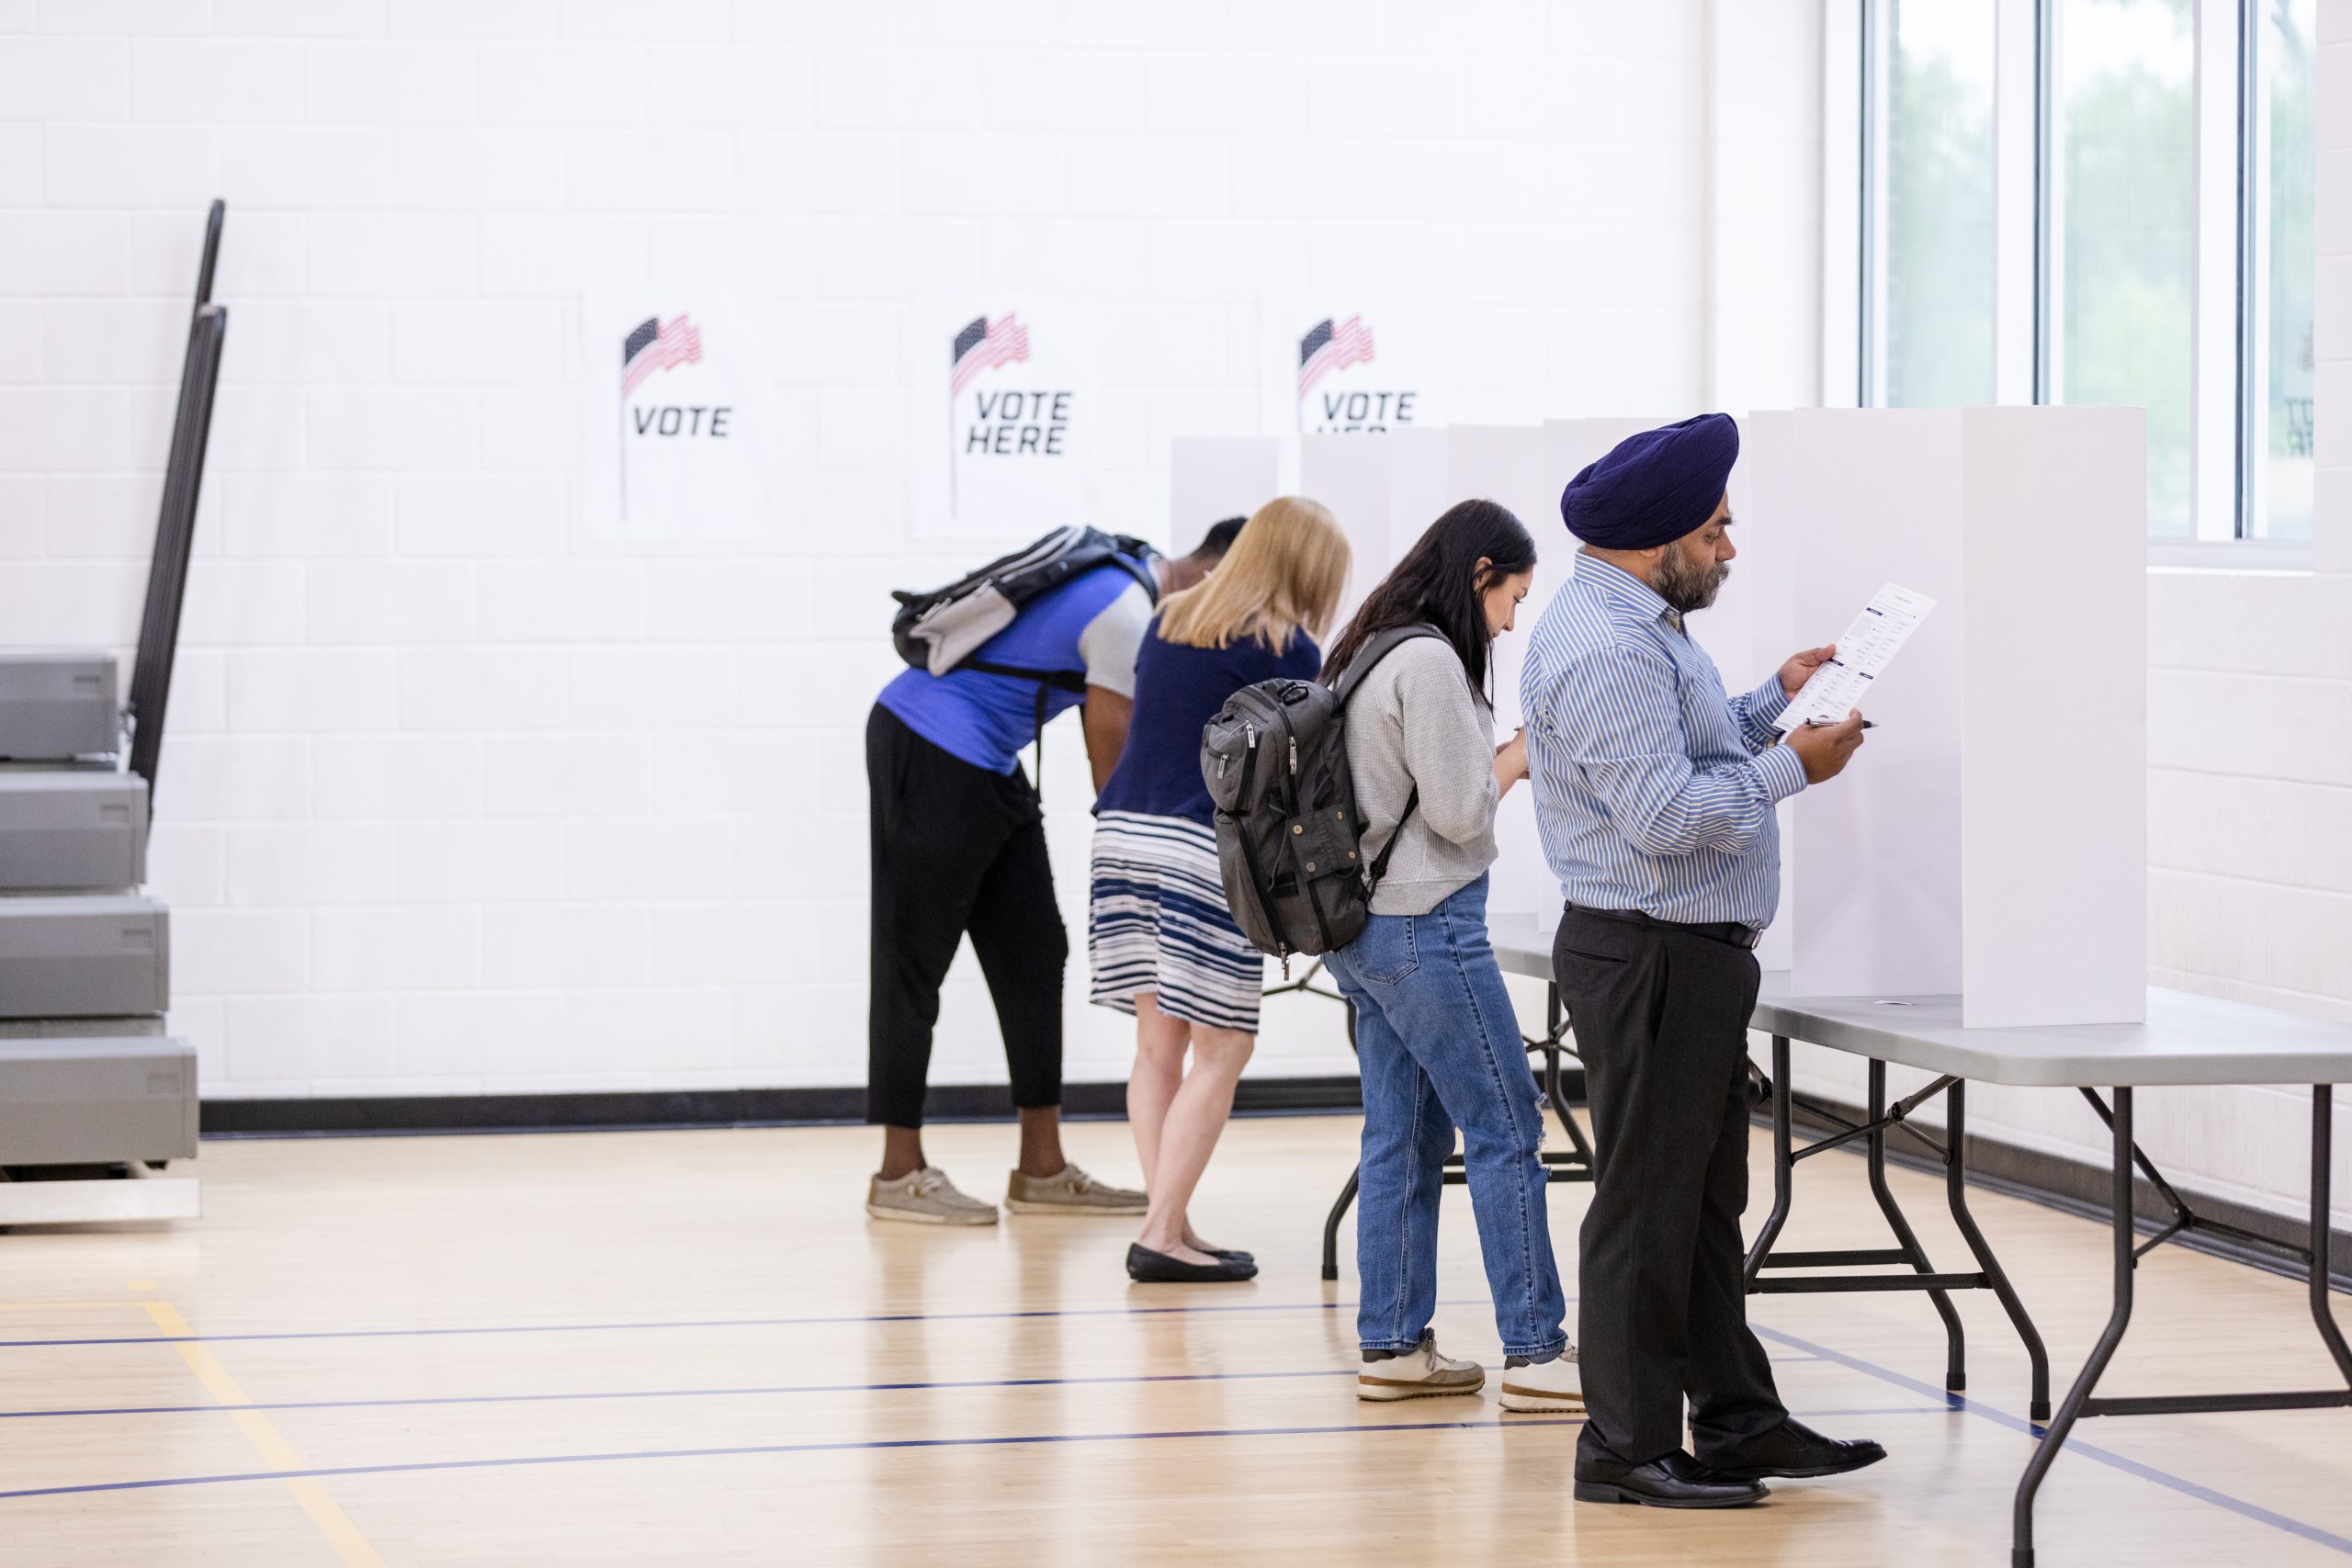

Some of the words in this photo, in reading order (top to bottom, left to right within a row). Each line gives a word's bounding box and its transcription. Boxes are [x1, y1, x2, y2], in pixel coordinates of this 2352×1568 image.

[977, 392, 1073, 421] VOTE
[1324, 392, 1417, 422] VOTE
[634, 406, 732, 438] VOTE
[967, 425, 1066, 456] HERE
